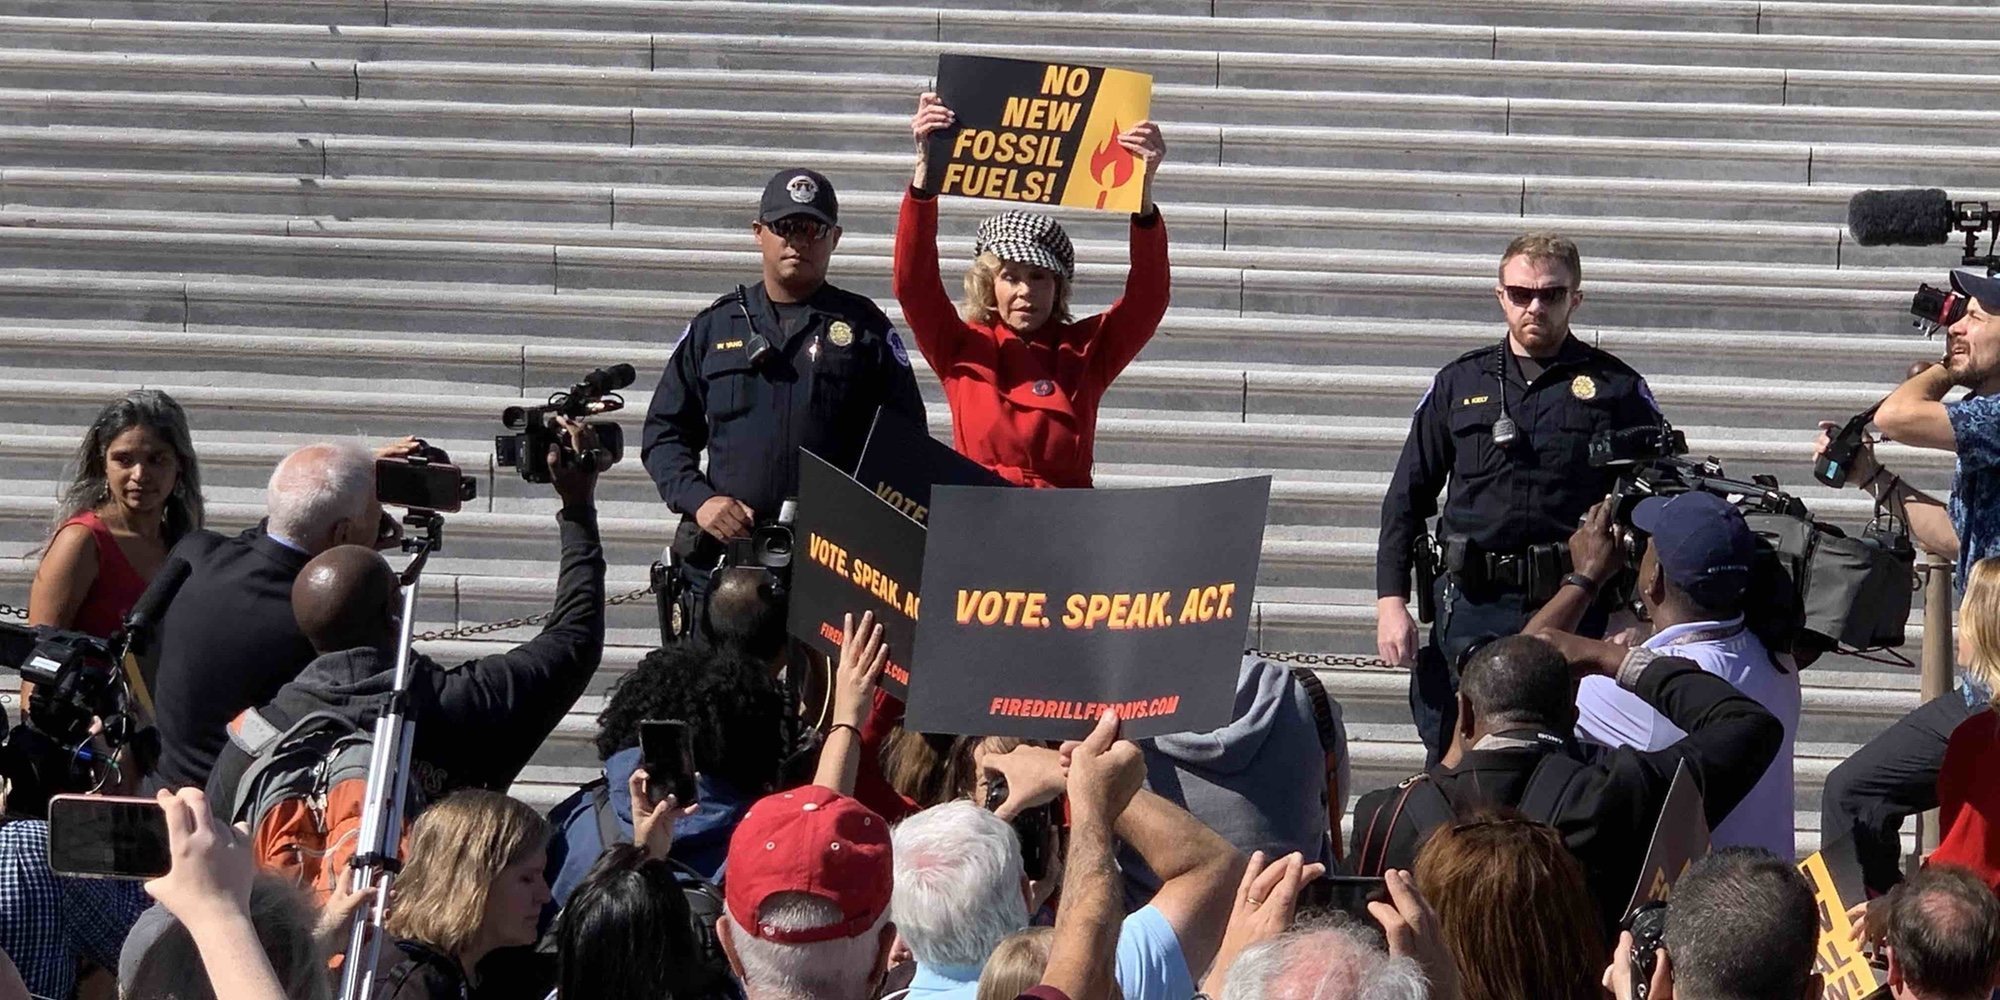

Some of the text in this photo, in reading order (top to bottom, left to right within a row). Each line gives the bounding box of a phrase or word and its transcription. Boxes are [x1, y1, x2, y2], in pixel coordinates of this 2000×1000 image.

[1041, 65, 1091, 97] NO
[1001, 97, 1082, 132] NEW
[952, 129, 1064, 168] FOSSIL
[941, 163, 1057, 203] FUELS!
[809, 532, 850, 579] VOTE.
[852, 558, 901, 611] SPEAK.
[955, 582, 1236, 630] VOTE. SPEAK. ACT.
